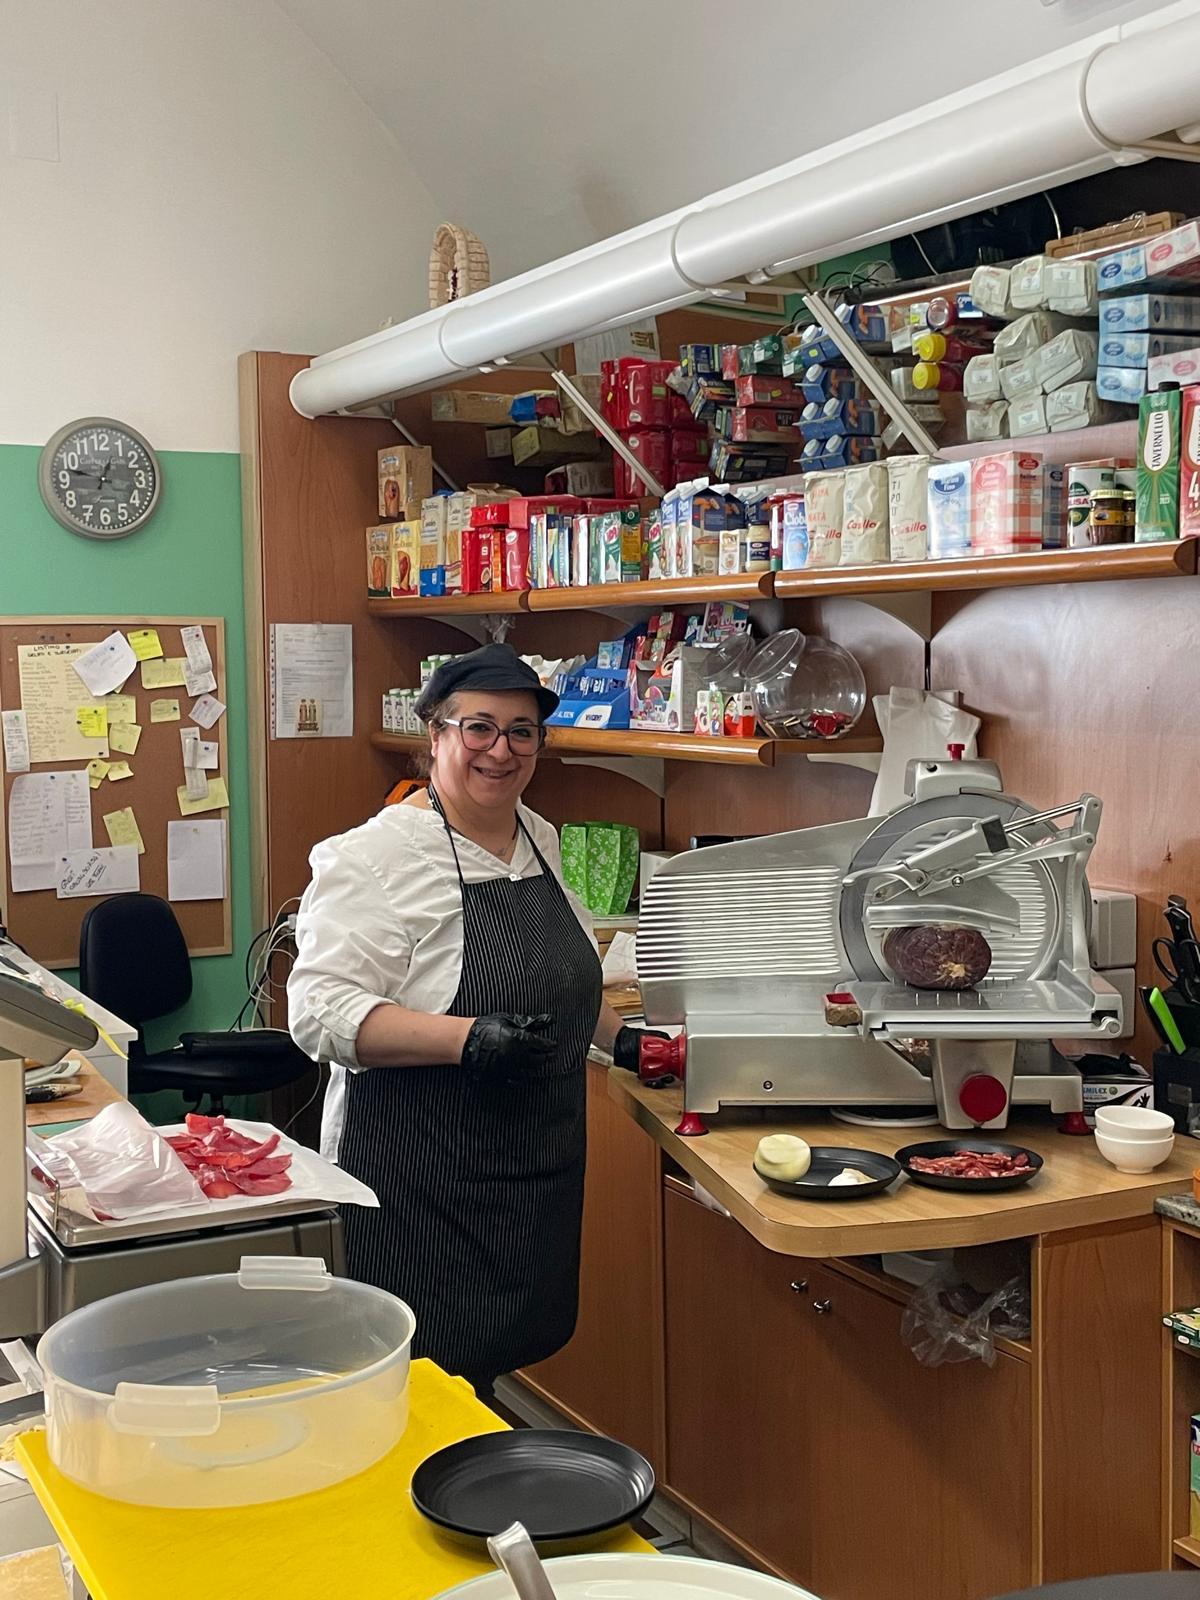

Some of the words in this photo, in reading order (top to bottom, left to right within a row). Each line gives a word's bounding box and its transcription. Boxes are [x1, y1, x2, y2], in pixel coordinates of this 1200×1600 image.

[74, 437, 89, 456] 11
[90, 433, 110, 451] 12
[114, 439, 123, 457] 1
[1152, 412, 1164, 468] TAVERNELLO
[61, 451, 79, 470] 10
[127, 450, 139, 469] 2
[58, 470, 71, 489] 9
[135, 469, 146, 488] 3
[65, 490, 77, 508] 8
[129, 489, 141, 507] 4
[82, 504, 94, 522] 7
[99, 507, 111, 525] 6
[117, 503, 128, 521] 5
